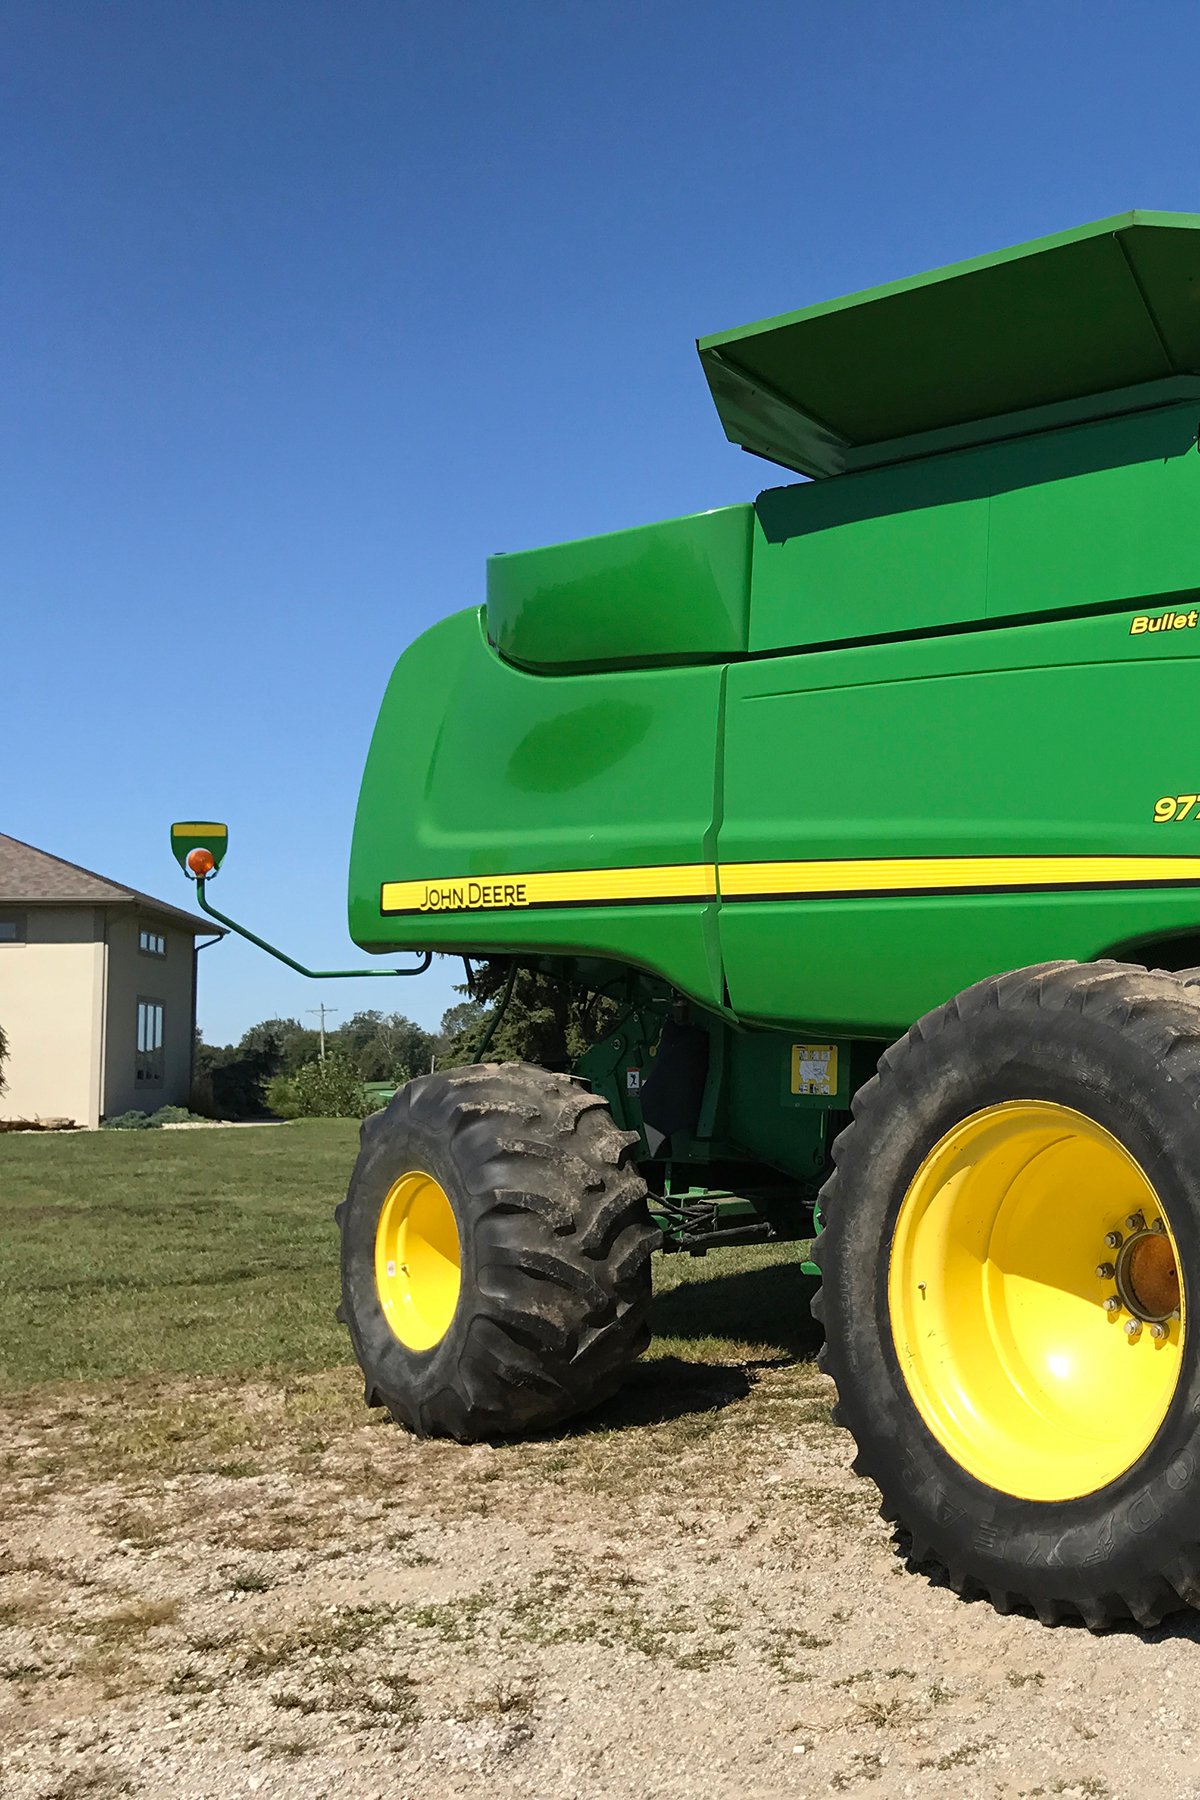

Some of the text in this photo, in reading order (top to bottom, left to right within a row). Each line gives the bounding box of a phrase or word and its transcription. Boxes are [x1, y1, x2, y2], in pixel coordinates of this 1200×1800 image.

[1129, 610, 1199, 635] Bullet
[420, 882, 527, 908] JOHN DEERE
